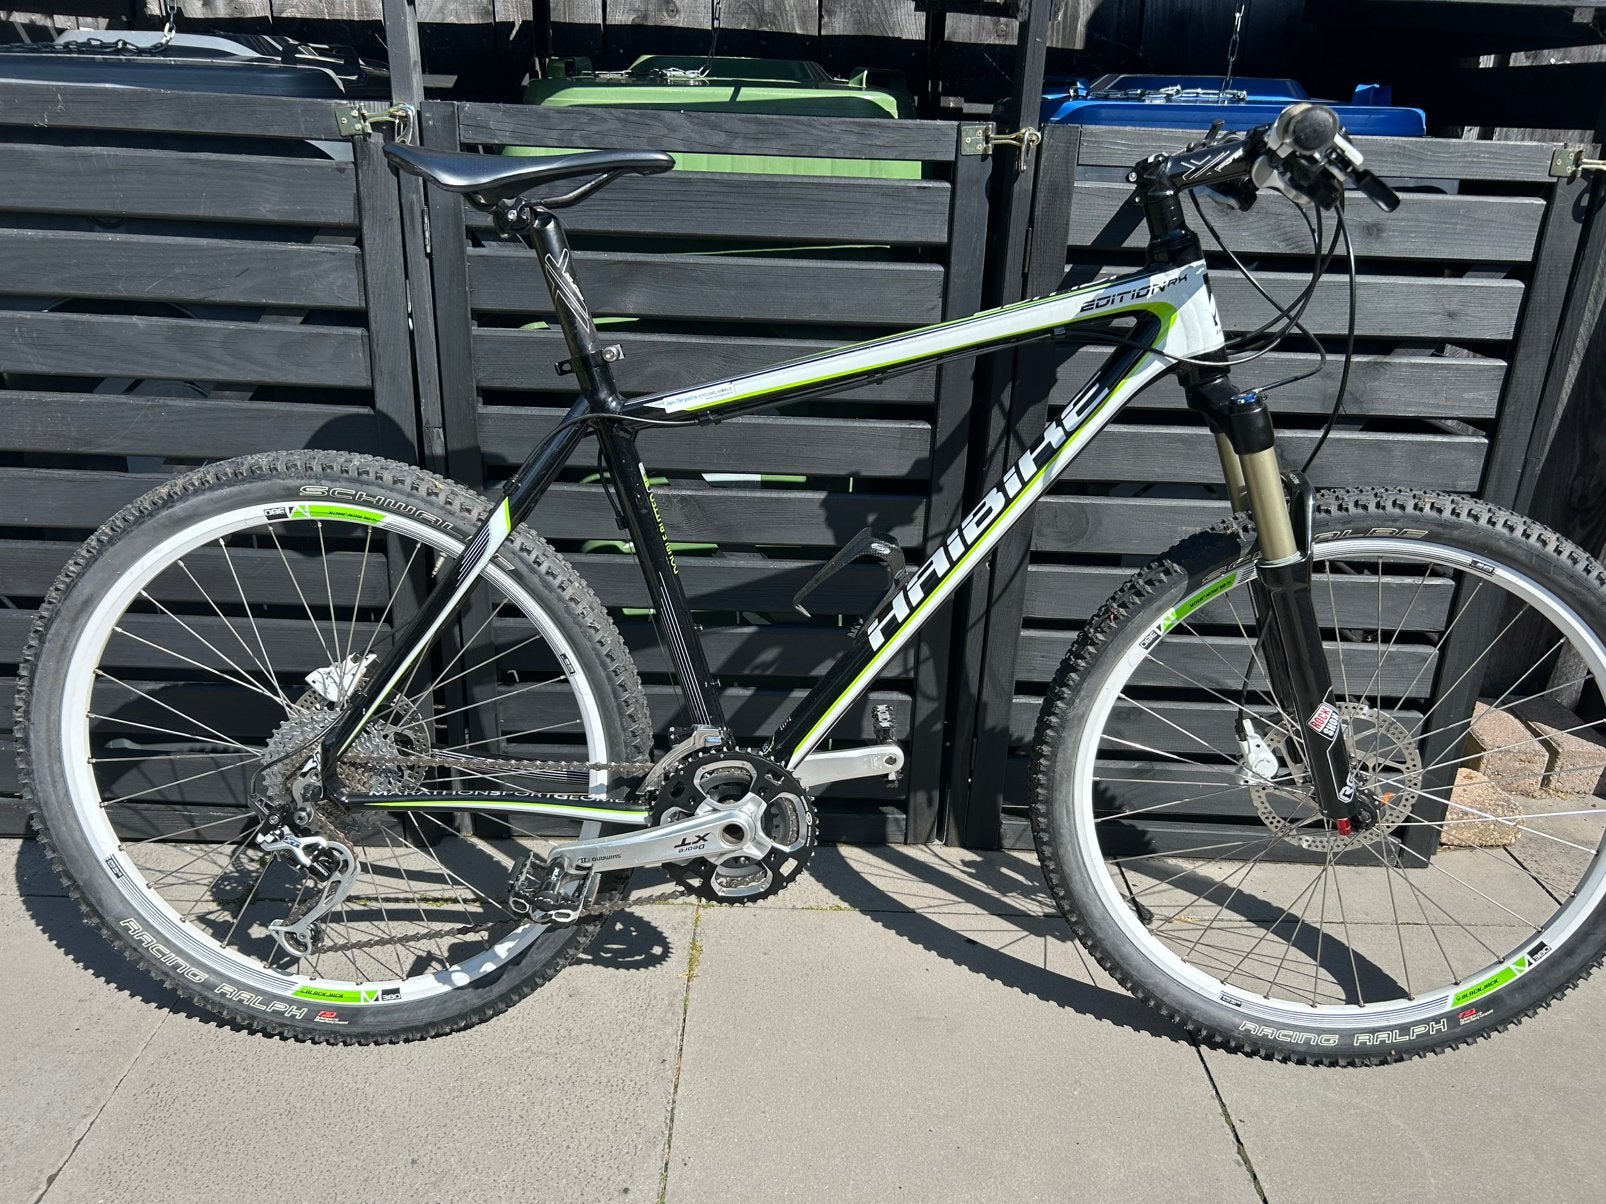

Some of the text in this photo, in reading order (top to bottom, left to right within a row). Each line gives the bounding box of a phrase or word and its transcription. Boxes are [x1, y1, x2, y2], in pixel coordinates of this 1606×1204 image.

[1310, 707, 1332, 730] ROCK
[673, 832, 712, 849] XT
[678, 843, 705, 853] Deore
[120, 917, 308, 1020] RACING RALPH
[1239, 1018, 1448, 1047] RACING RALPH
